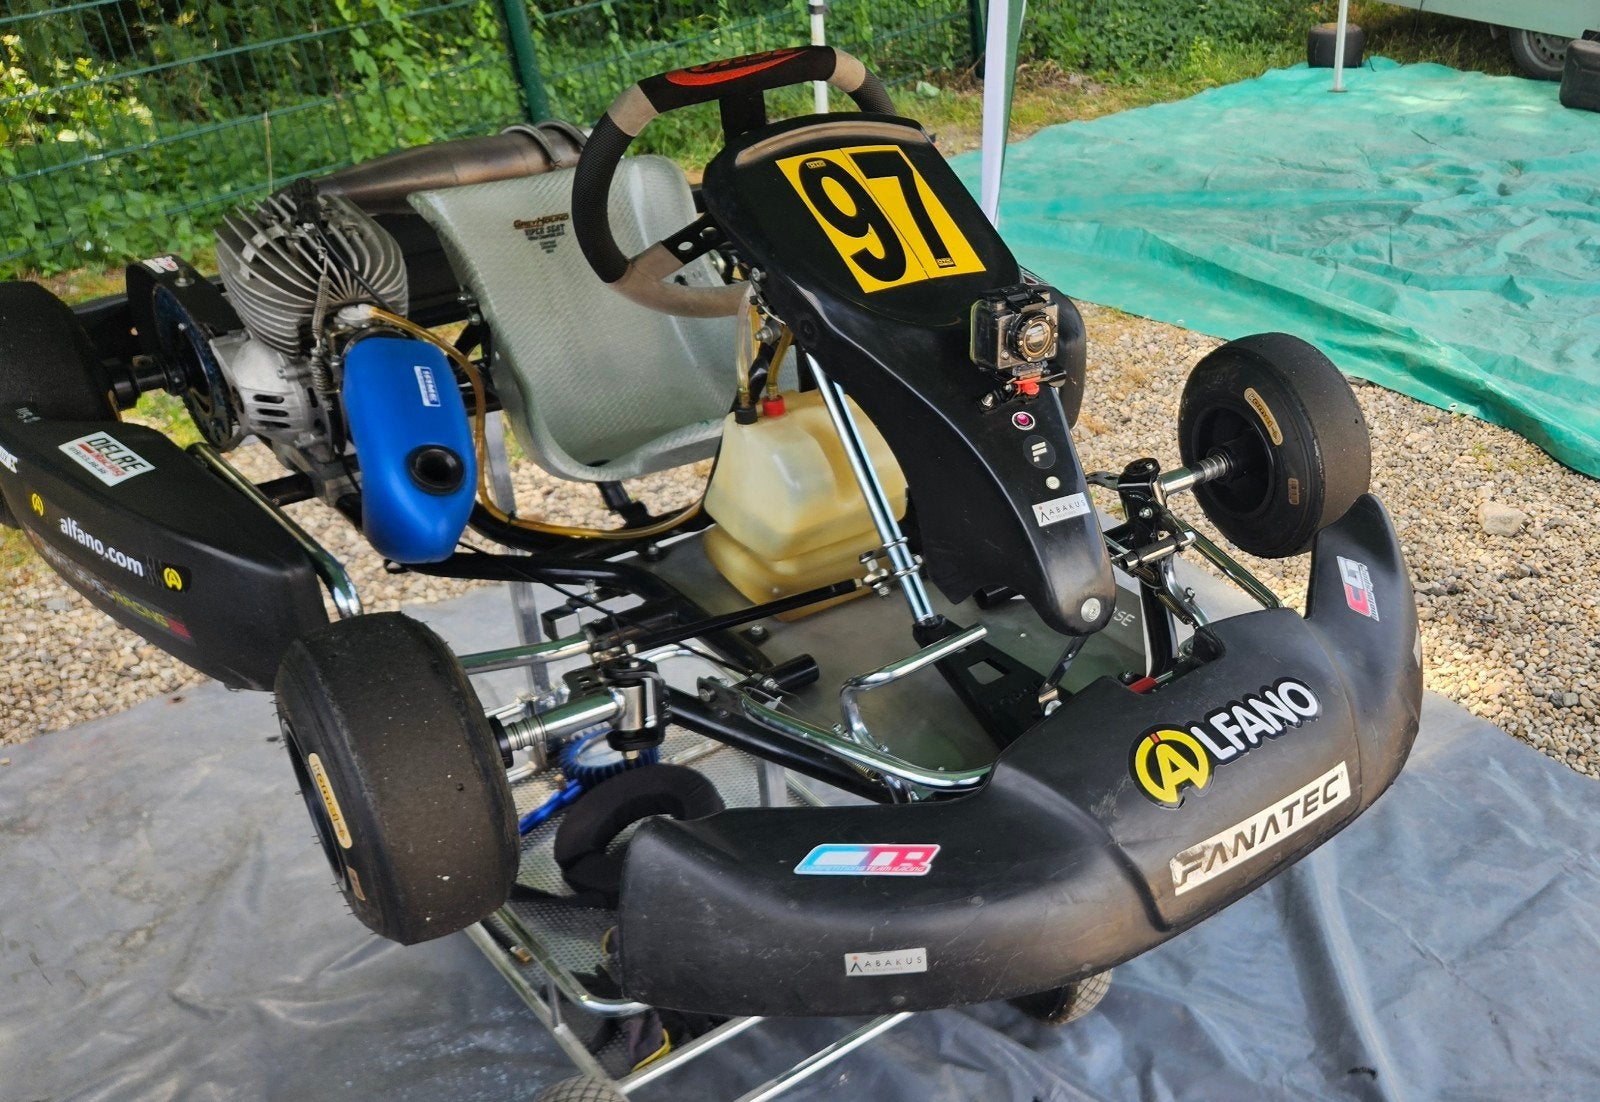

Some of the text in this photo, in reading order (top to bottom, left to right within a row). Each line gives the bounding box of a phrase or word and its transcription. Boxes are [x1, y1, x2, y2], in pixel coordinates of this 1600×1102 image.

[799, 151, 956, 282] 97
[87, 437, 146, 472] DELRE
[1049, 500, 1087, 515] ABAKUS
[60, 517, 144, 577] alfano.com
[1135, 681, 1319, 803] ALFANO
[1174, 774, 1339, 888] FANATEC
[864, 956, 923, 968] ABAKUS
